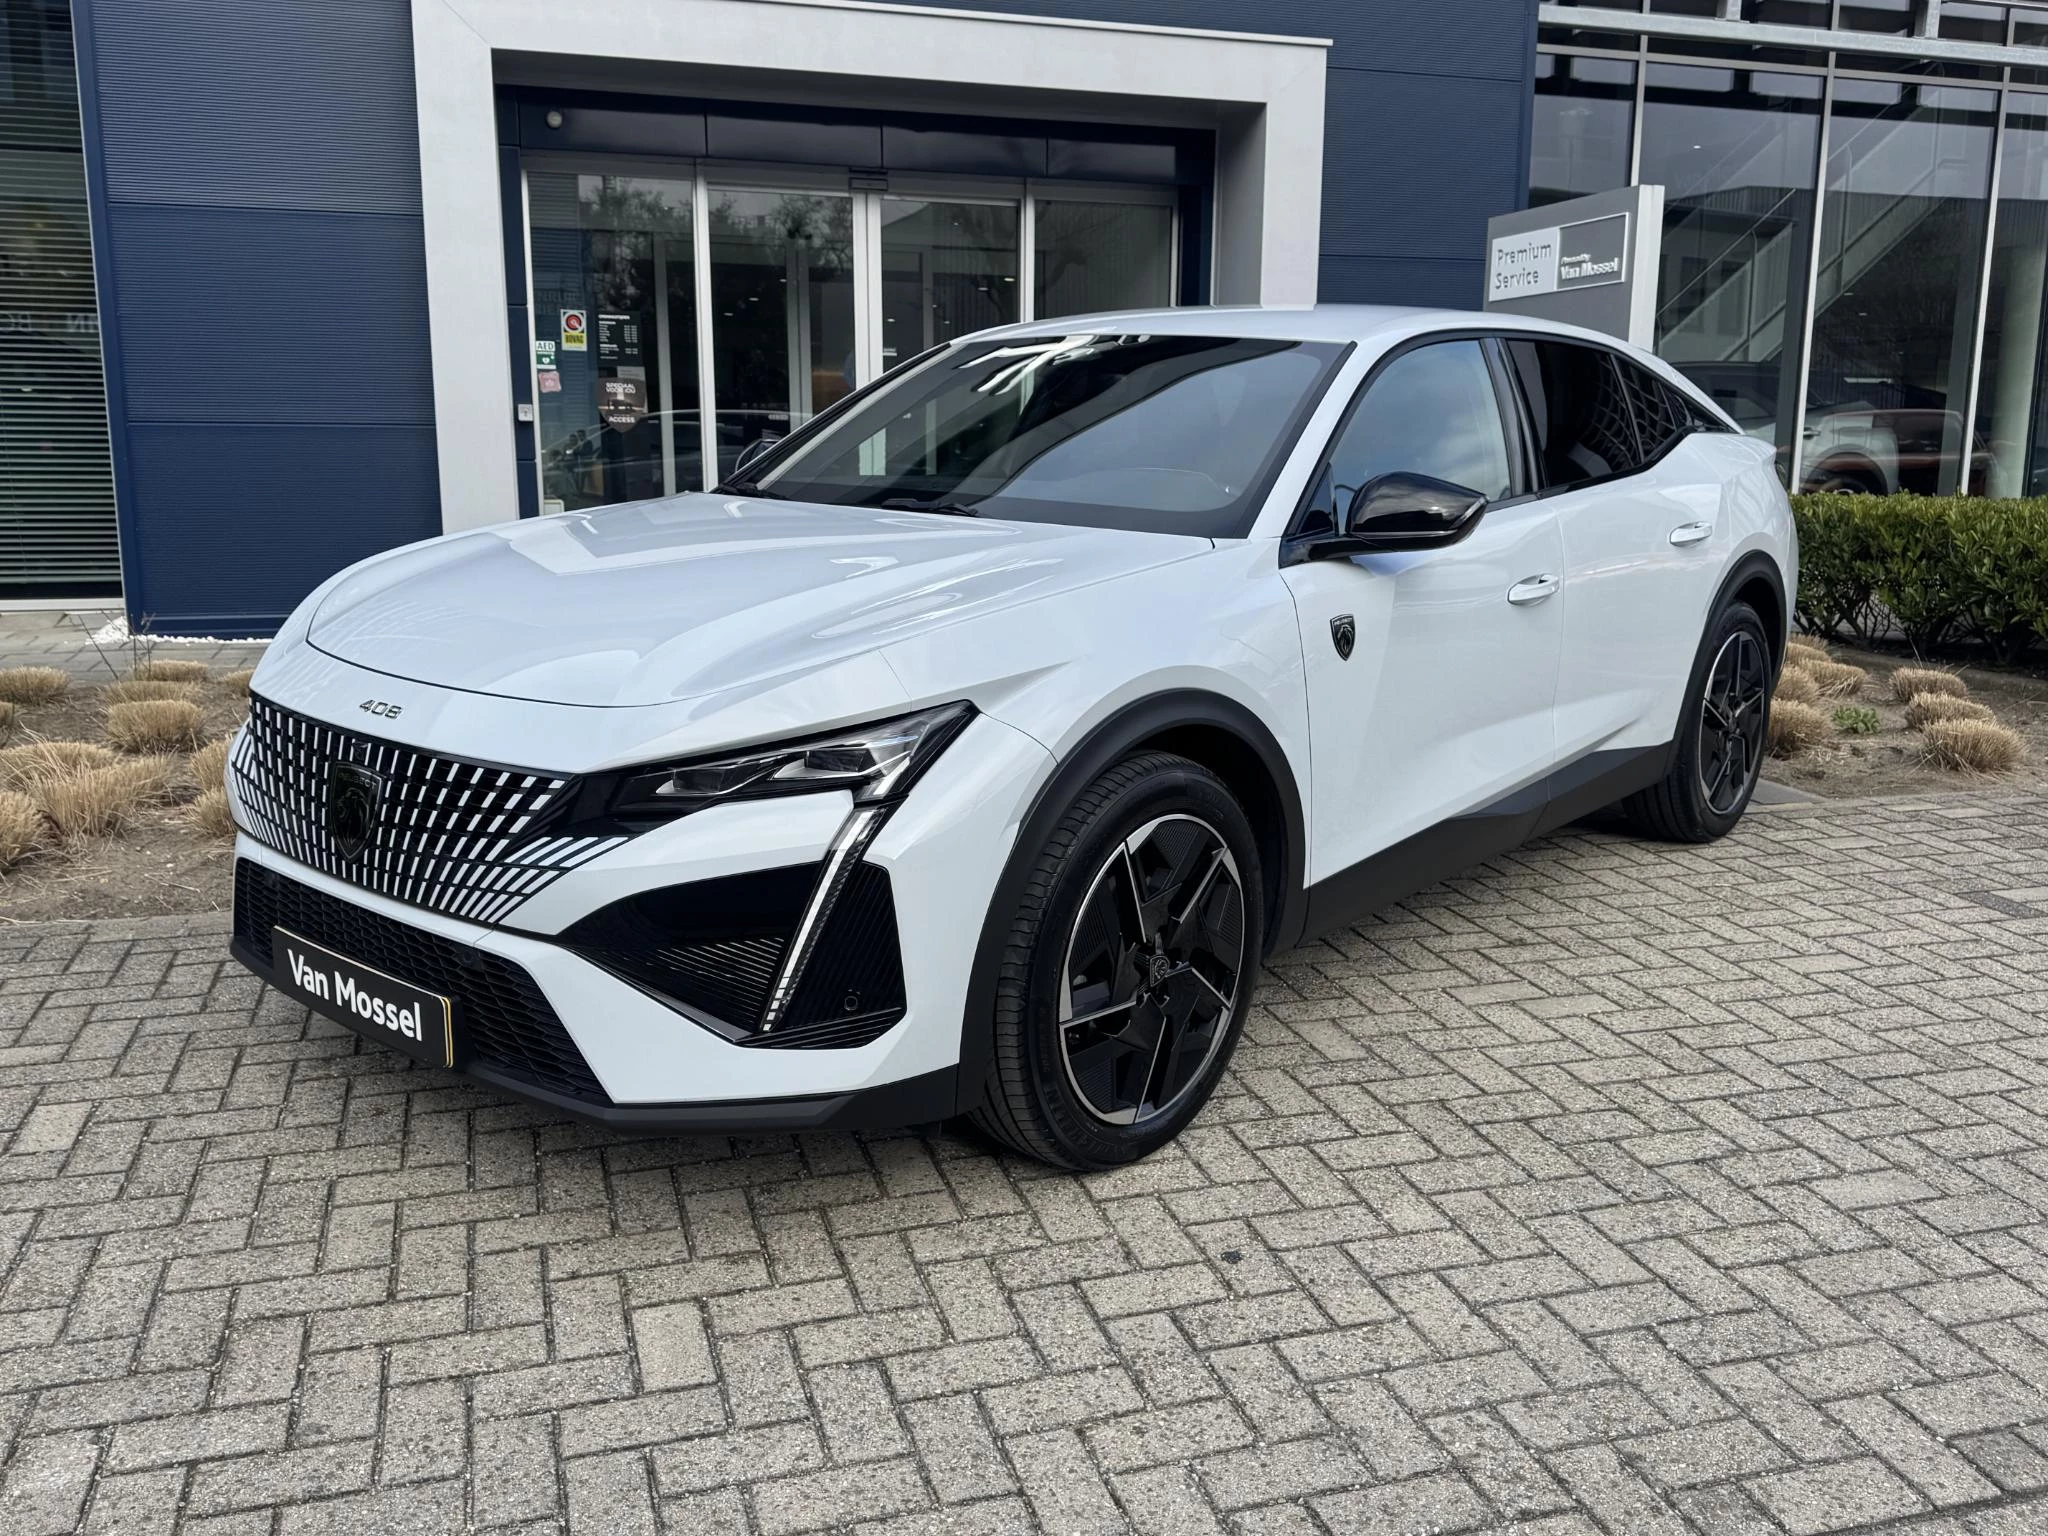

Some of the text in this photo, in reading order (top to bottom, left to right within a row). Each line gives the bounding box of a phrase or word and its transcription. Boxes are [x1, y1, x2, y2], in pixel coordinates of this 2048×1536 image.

[1497, 242, 1551, 265] Premium
[1495, 268, 1539, 290] Service
[1561, 265, 1580, 280] Van
[1581, 257, 1618, 276] Mossel
[537, 342, 554, 351] AED
[359, 699, 402, 720] 408
[287, 948, 423, 1042] Van Mossel
